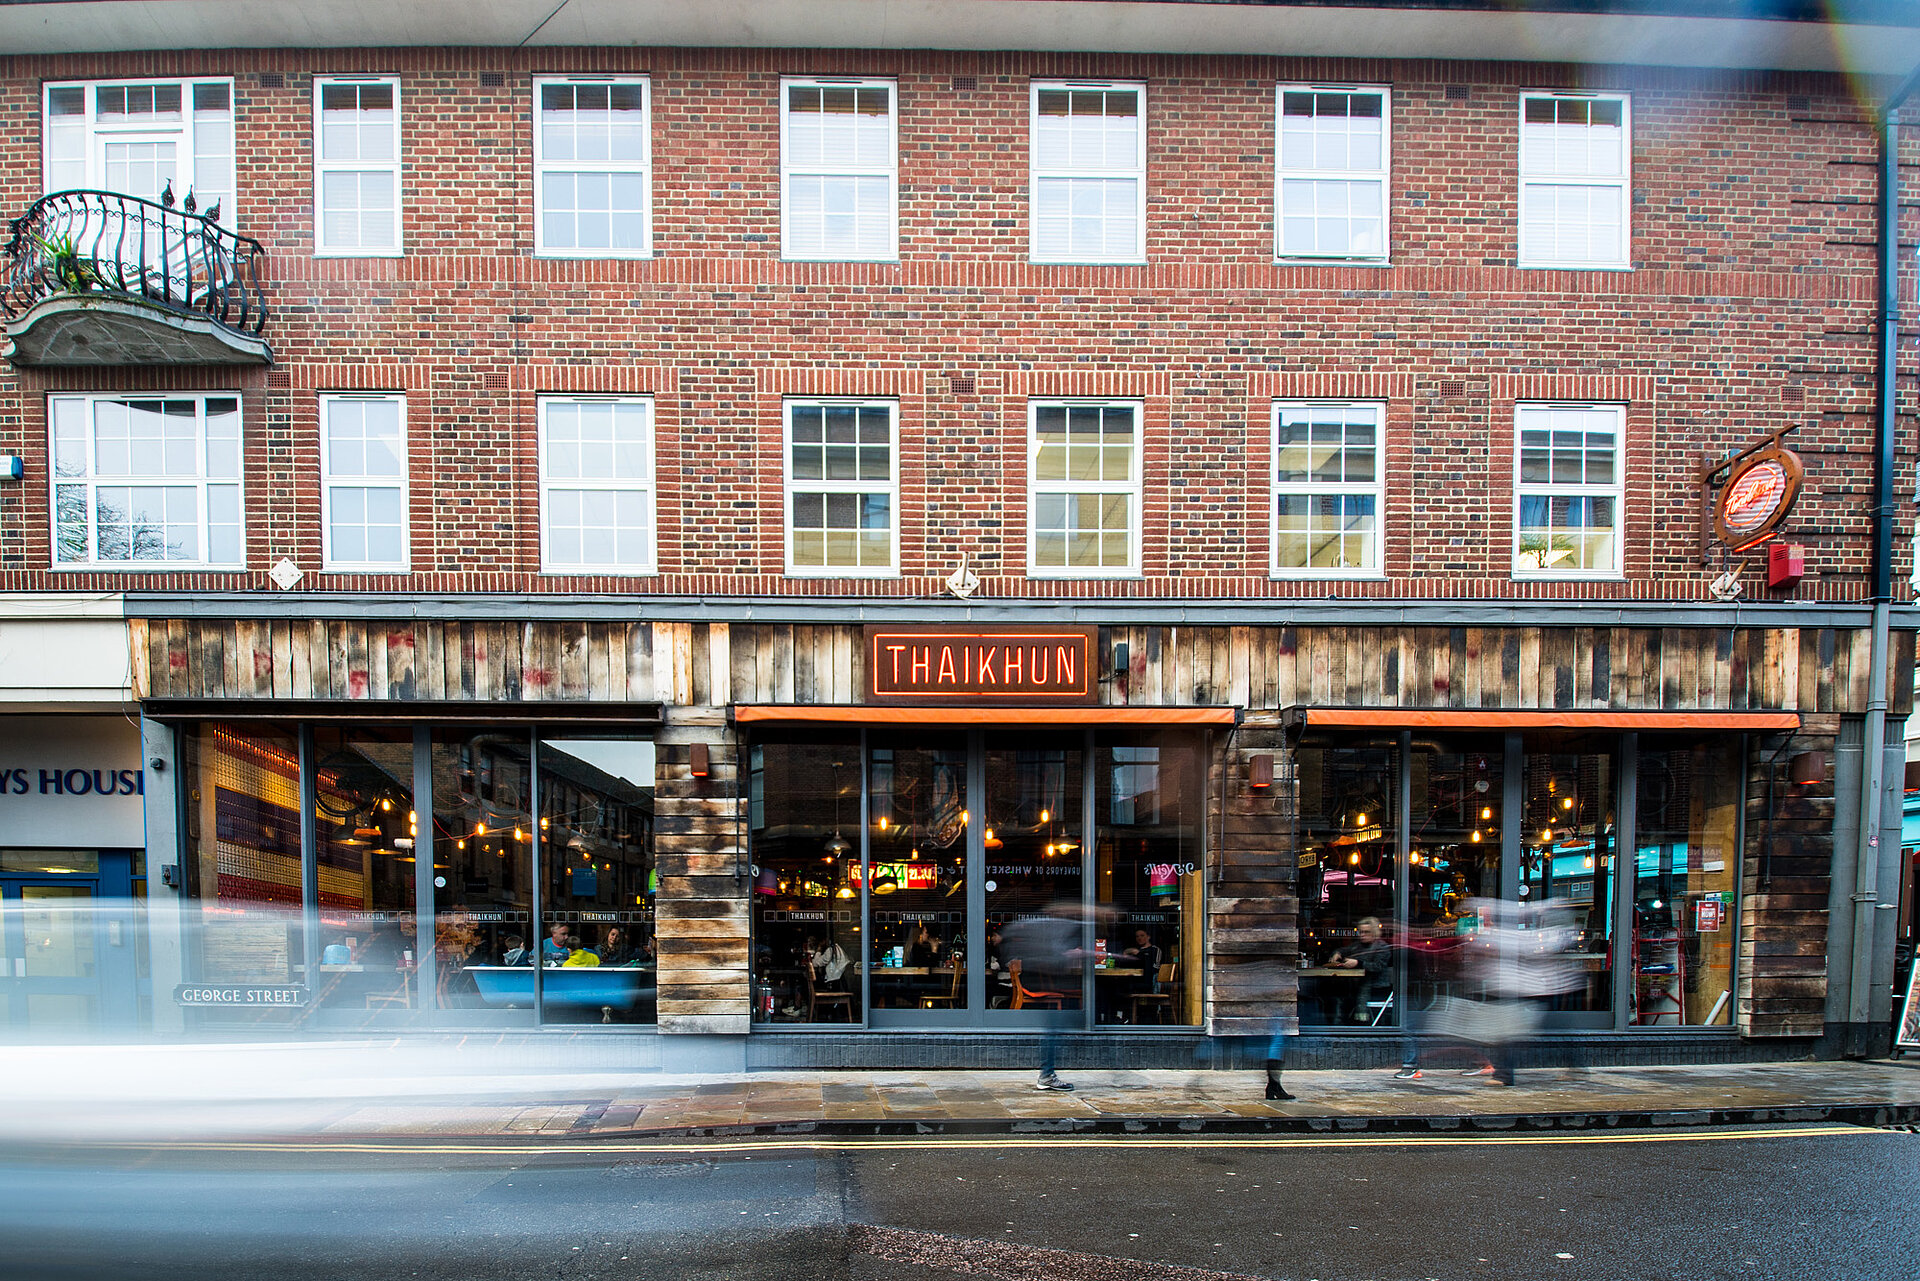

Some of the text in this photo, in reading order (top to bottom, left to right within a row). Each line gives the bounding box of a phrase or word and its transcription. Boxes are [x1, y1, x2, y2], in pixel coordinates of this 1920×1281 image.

[886, 645, 1076, 685] THAIKHUN
[350, 912, 385, 921] THAIKHUN
[468, 913, 502, 921] THAIKHUN
[582, 913, 616, 921] THAIKHUN
[791, 912, 824, 920] THAIKHUN
[902, 913, 935, 921] THAIKHUN
[1131, 914, 1165, 922] THAIKHUN
[182, 989, 300, 1003] GEORGE STREET
